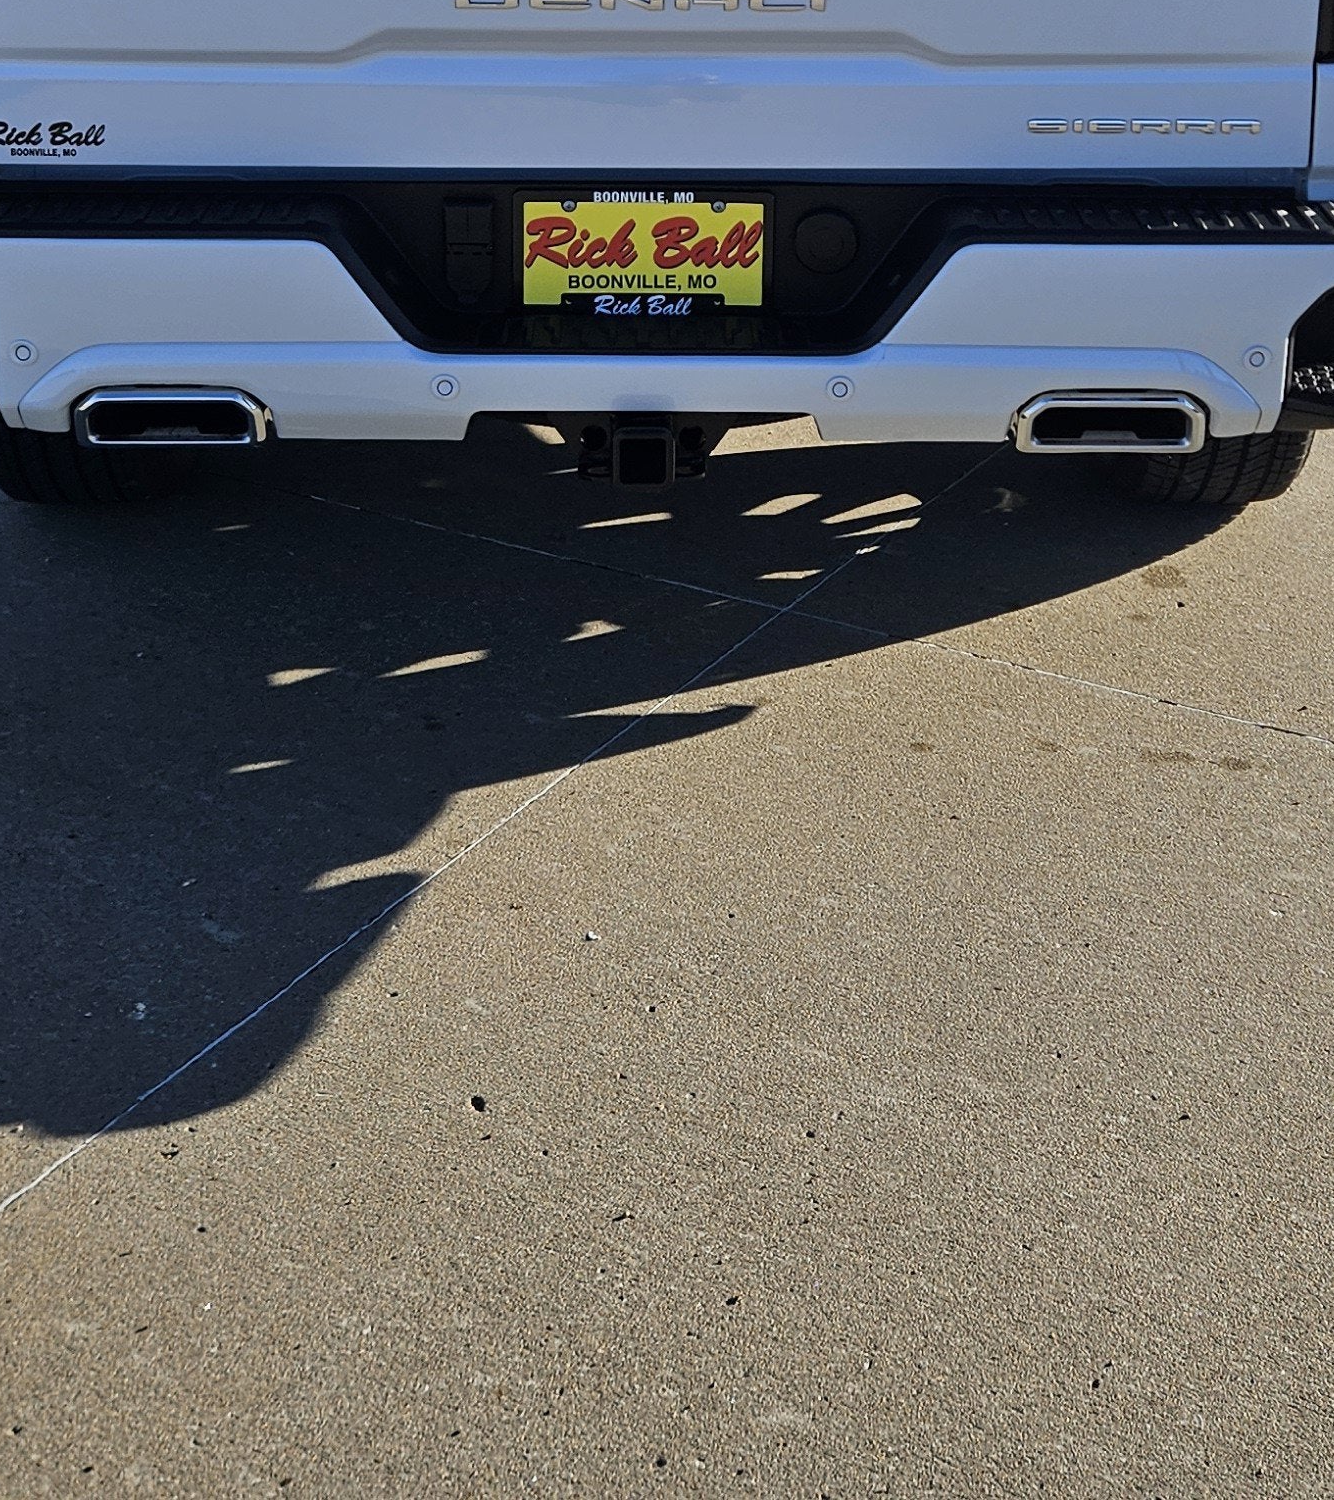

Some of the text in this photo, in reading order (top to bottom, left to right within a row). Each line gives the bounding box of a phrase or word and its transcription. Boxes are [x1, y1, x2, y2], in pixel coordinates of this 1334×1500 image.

[48, 121, 106, 146] Ball
[1027, 118, 1262, 134] SIERRA
[10, 148, 77, 157] BOONVILLE, MO
[593, 191, 695, 204] BOONVILLE, MO
[525, 216, 764, 269] Rick Ball
[568, 274, 717, 291] BOONVILLE, MO
[593, 294, 693, 315] Rick Ball
